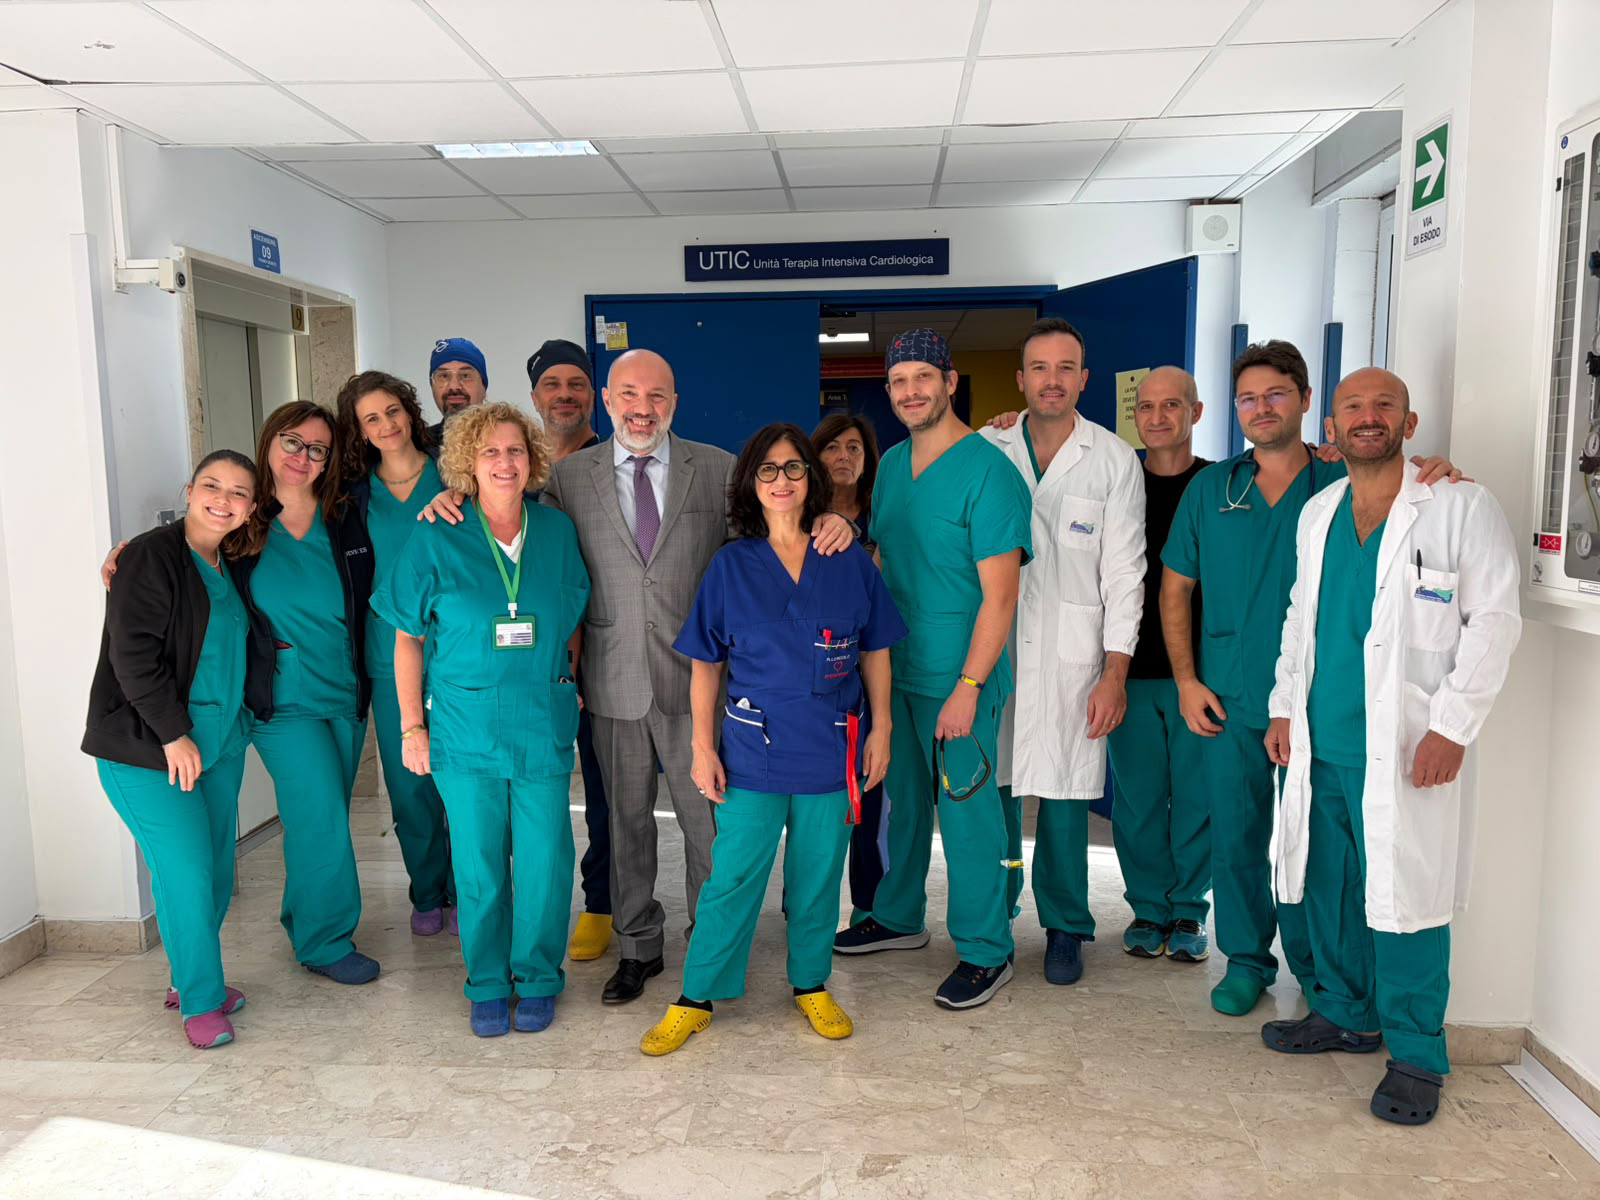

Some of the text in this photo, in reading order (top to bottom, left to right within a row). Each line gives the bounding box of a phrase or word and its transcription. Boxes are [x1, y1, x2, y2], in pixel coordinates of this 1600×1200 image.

[1423, 216, 1432, 227] VIA
[1413, 226, 1441, 246] DI ESODO
[262, 246, 271, 259] 09
[699, 250, 934, 270] UTIC Unità Terapia Intensiva Cardiologica
[296, 308, 302, 328] 9
